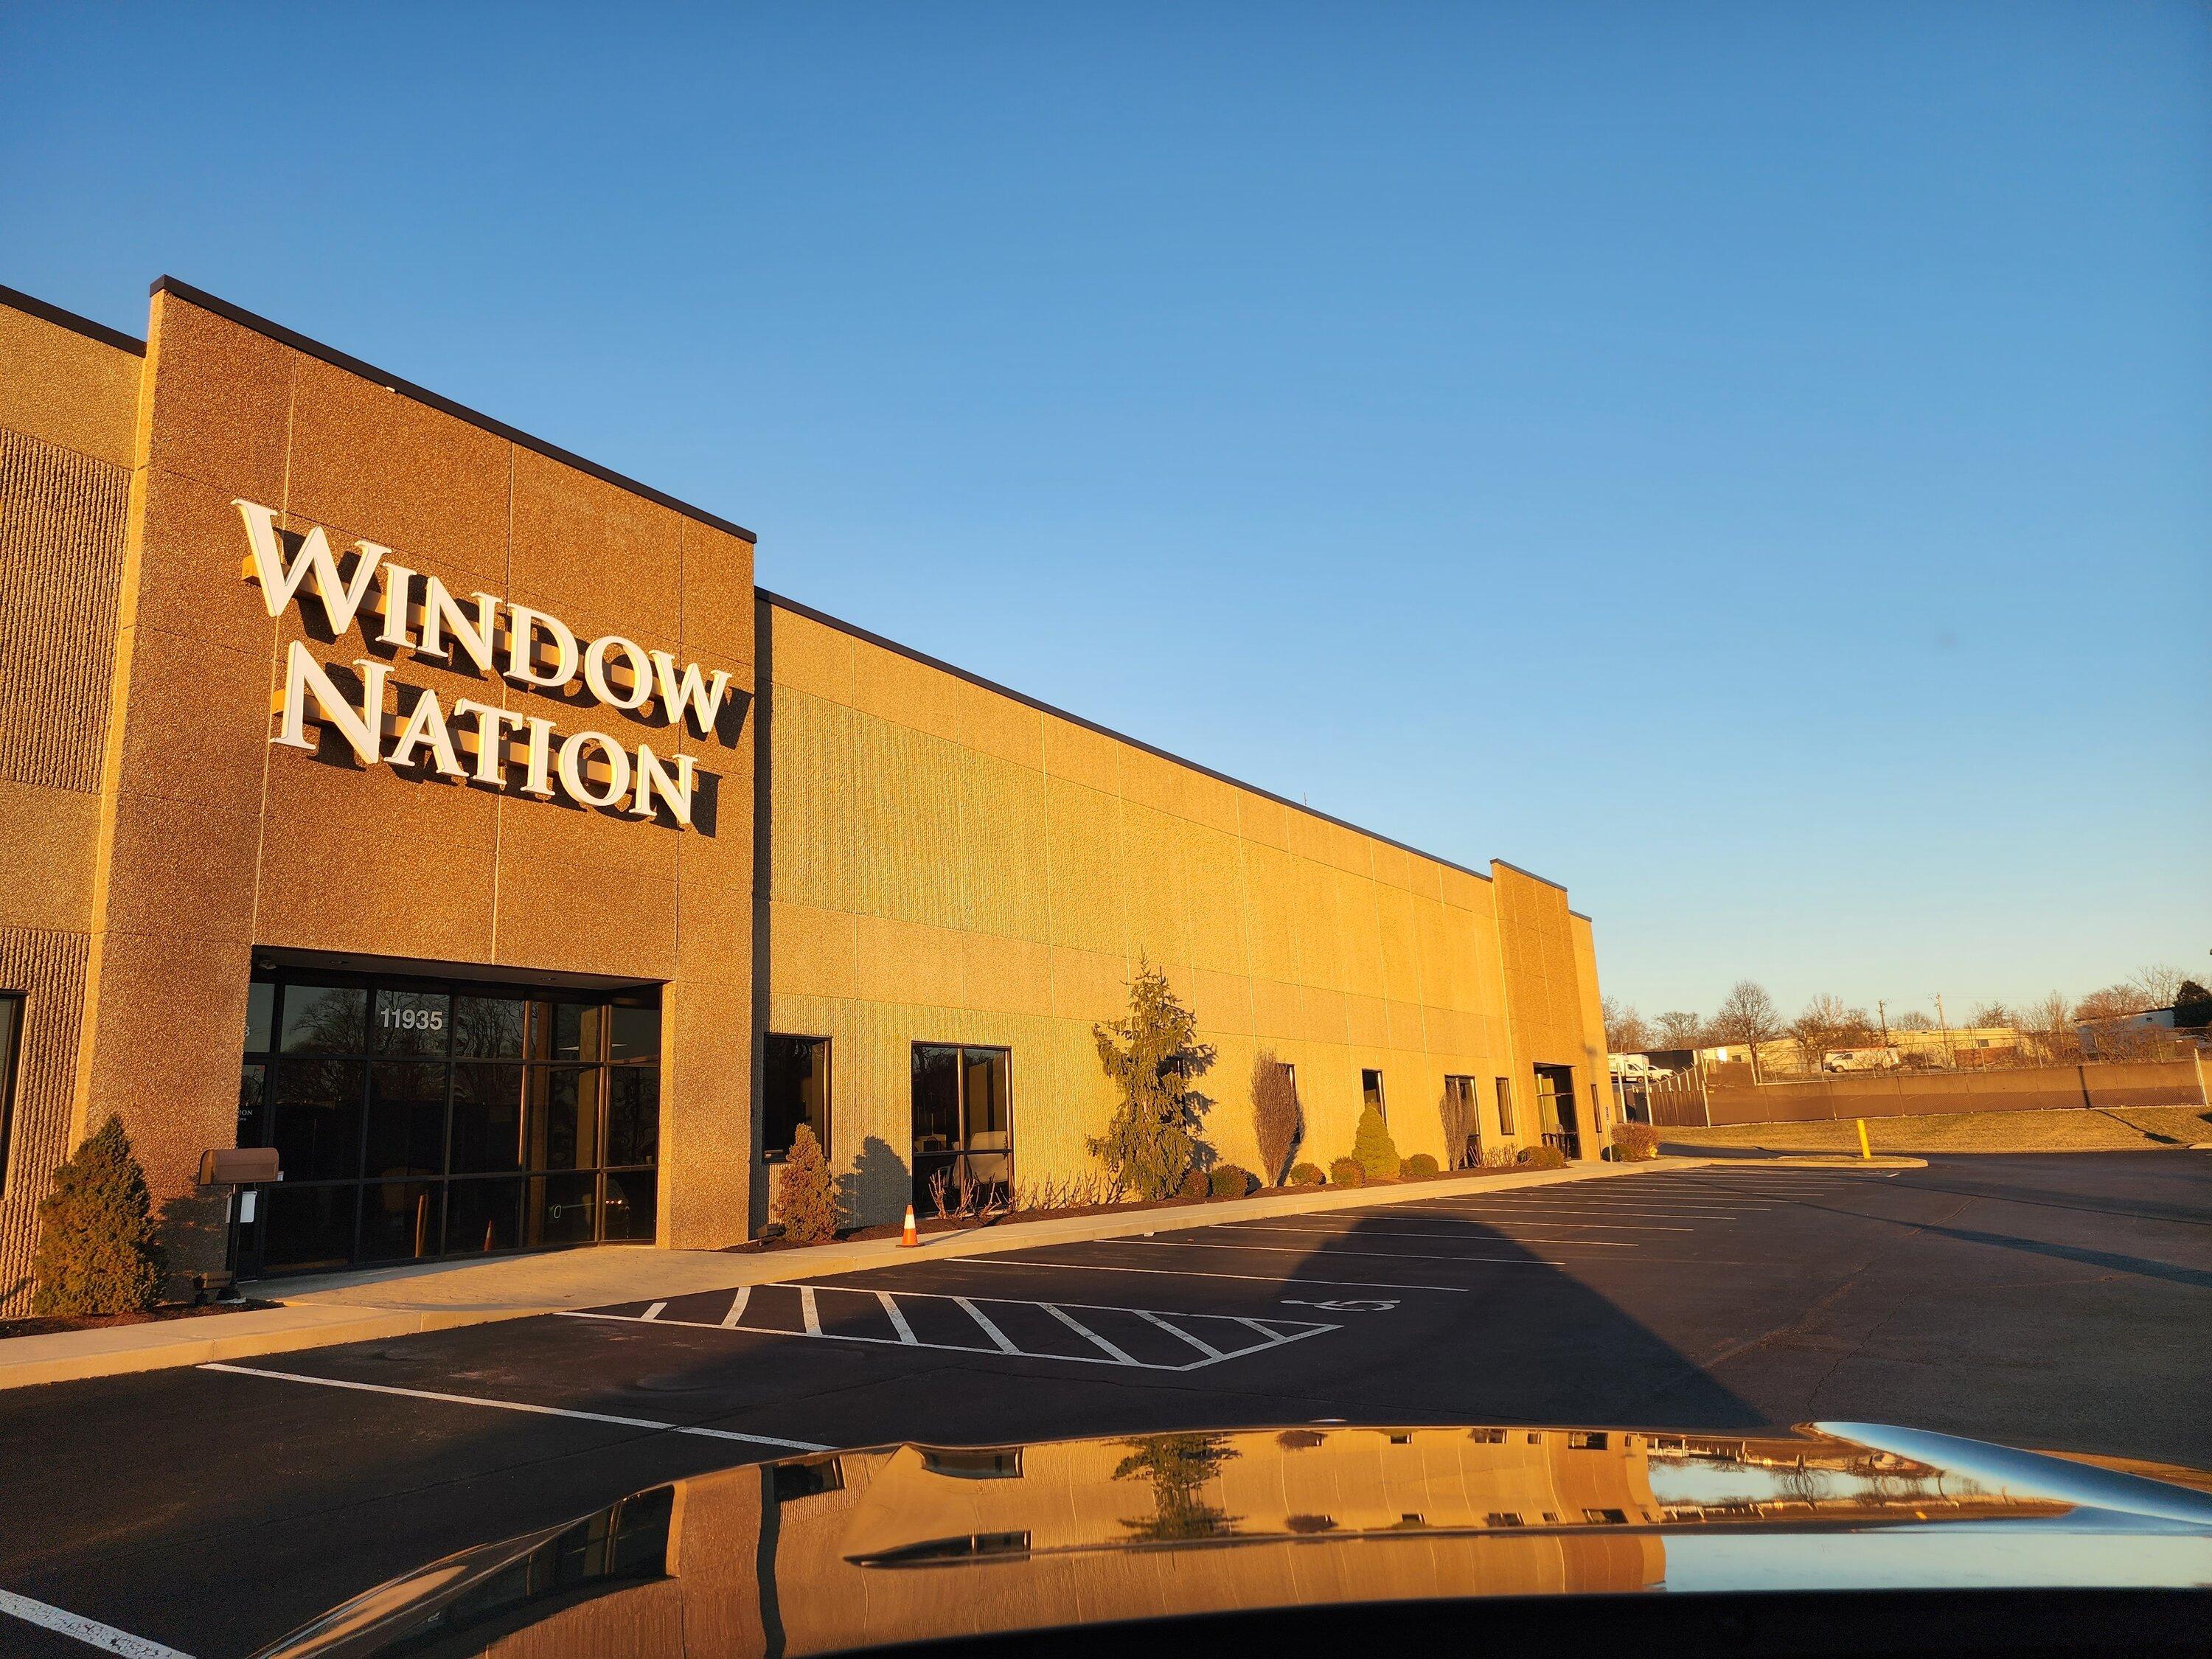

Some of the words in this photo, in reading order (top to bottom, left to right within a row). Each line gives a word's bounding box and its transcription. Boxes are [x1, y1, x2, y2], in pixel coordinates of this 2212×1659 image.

[231, 498, 732, 733] WINDOW
[270, 640, 698, 824] NATION
[380, 1008, 443, 1030] 11935
